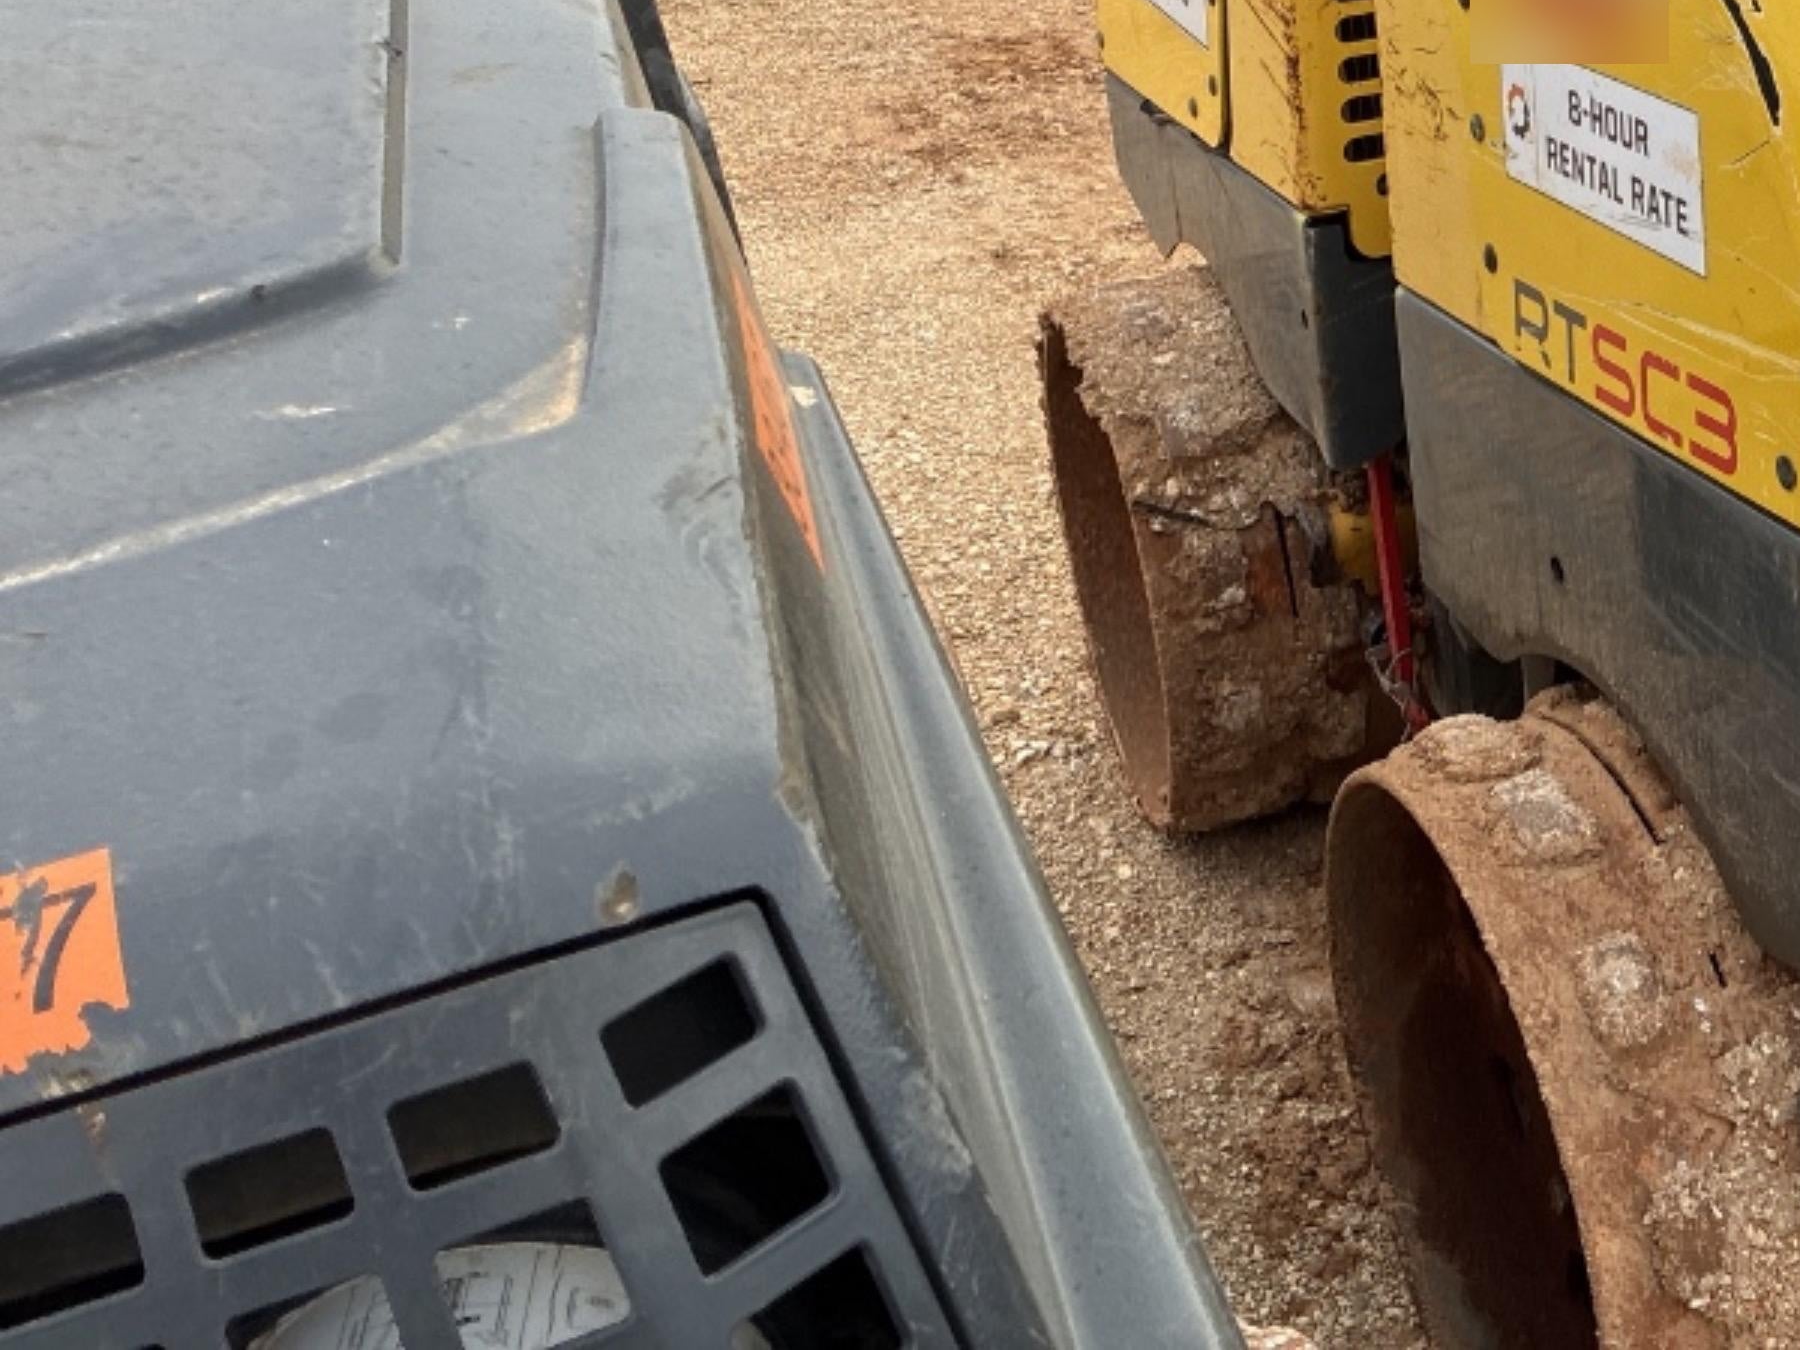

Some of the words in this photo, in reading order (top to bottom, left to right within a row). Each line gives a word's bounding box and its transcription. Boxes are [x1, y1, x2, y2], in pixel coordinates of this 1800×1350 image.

[1568, 88, 1649, 157] 8-HOUR
[1546, 135, 1624, 205] RENTAL
[1630, 175, 1689, 237] RATE
[1513, 278, 1738, 476] RTSC3
